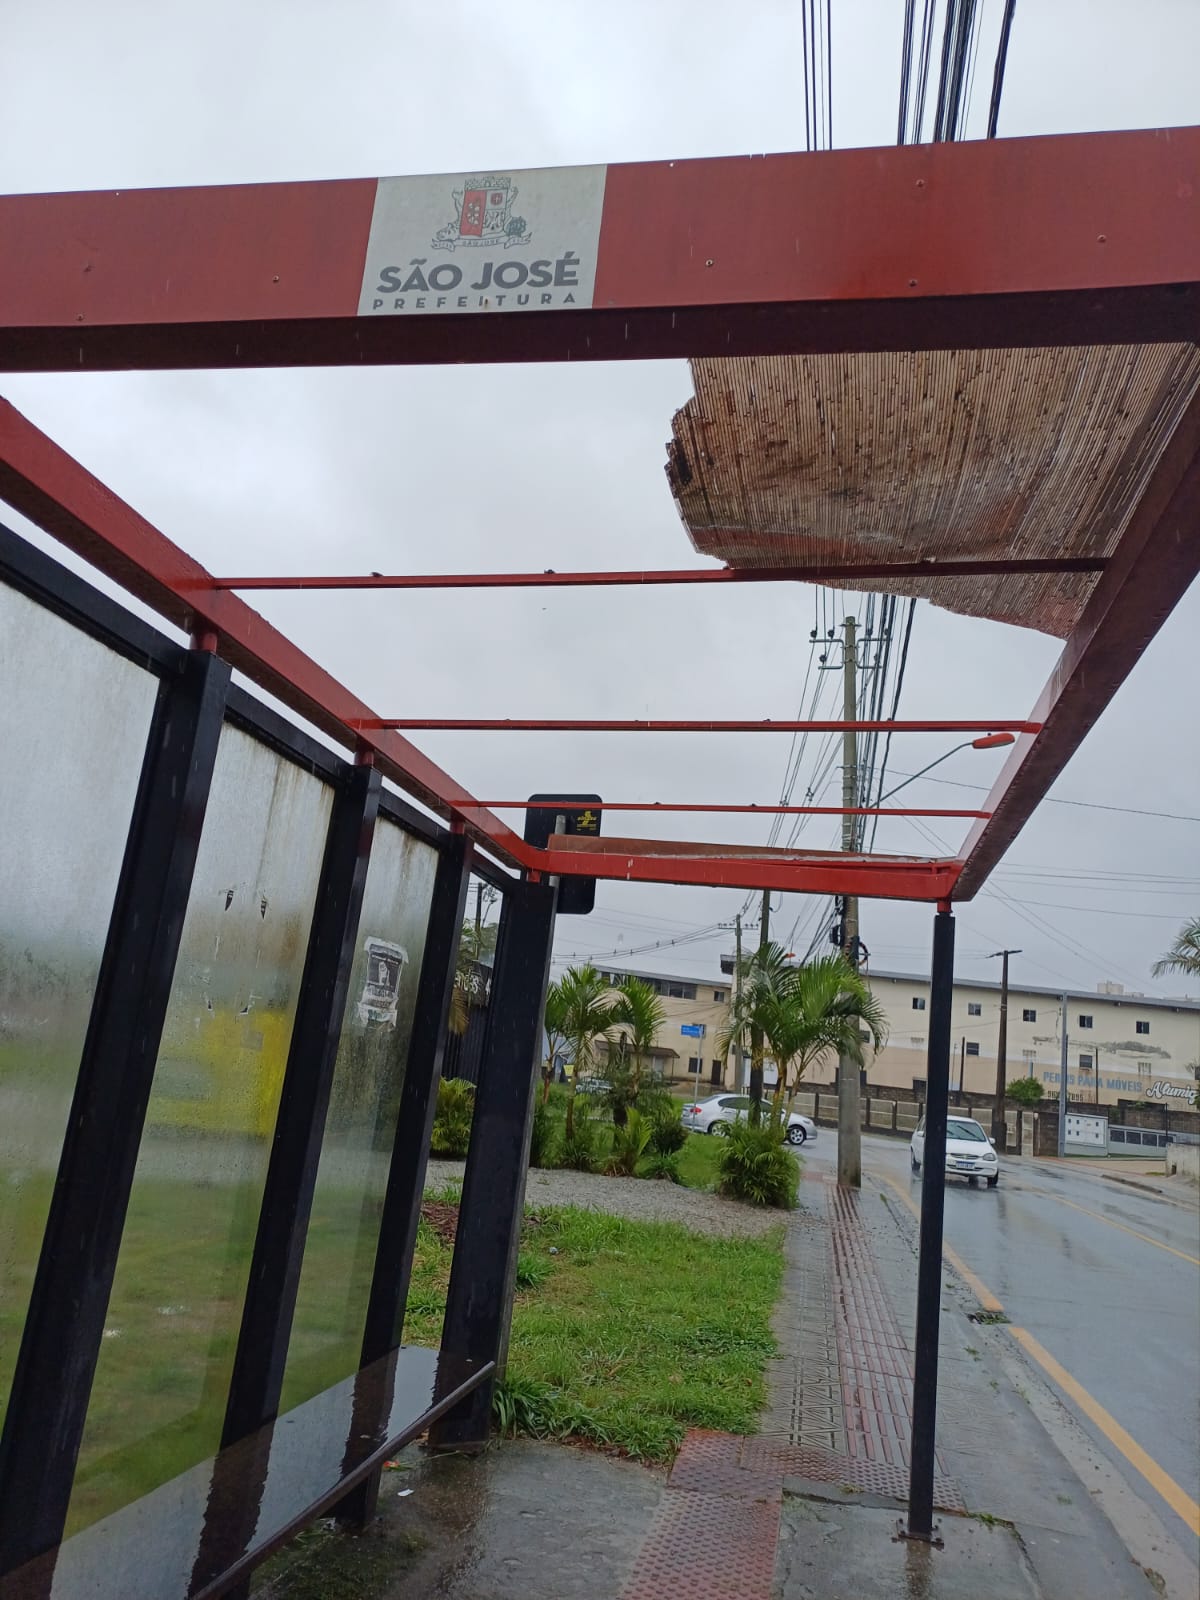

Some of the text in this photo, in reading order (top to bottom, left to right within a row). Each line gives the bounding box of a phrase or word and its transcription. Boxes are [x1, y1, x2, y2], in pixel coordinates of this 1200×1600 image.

[376, 251, 581, 293] SÃO JOSÉ
[373, 292, 576, 310] PREFEITURA
[1106, 1075, 1143, 1092] MÓVEIS
